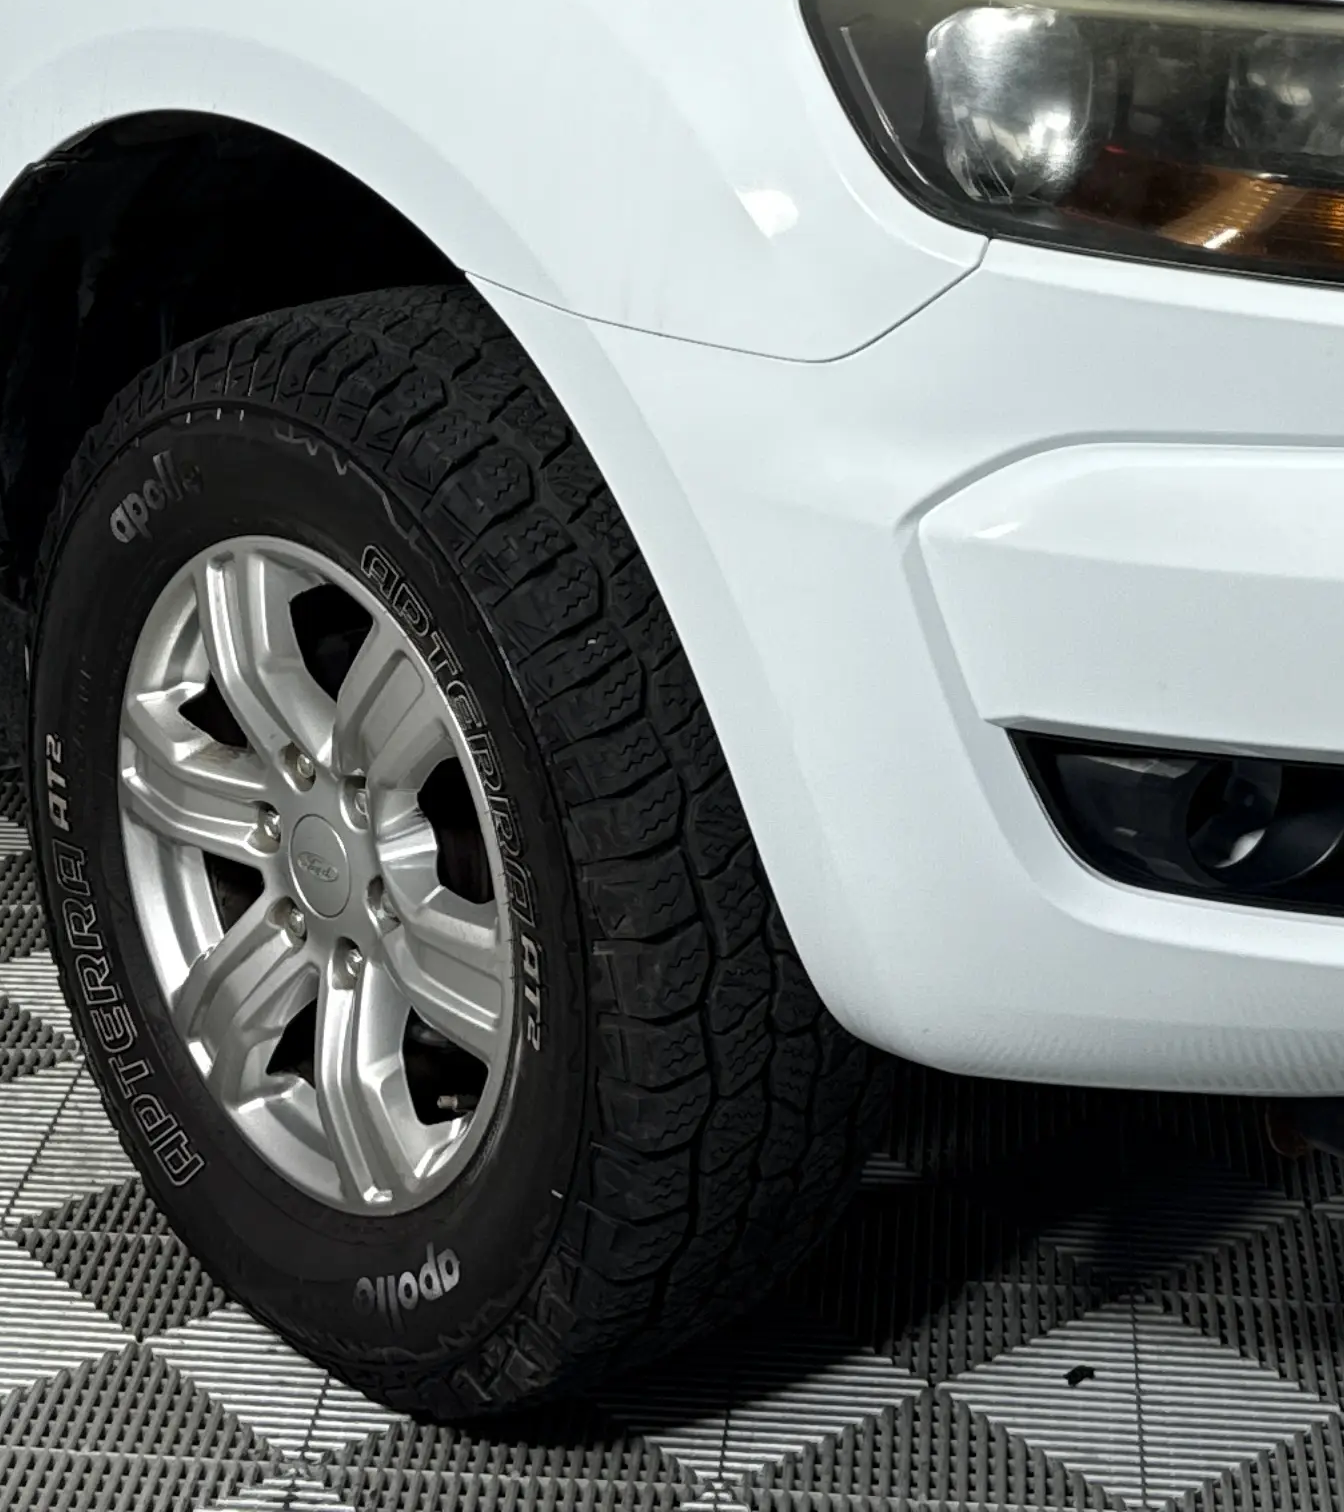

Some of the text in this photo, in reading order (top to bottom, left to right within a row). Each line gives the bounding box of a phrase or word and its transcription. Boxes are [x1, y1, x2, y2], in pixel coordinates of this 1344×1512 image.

[45, 732, 206, 1188] APTERRA AT2
[360, 542, 545, 1052] APTERRA AT2
[352, 1240, 461, 1336] apollo
